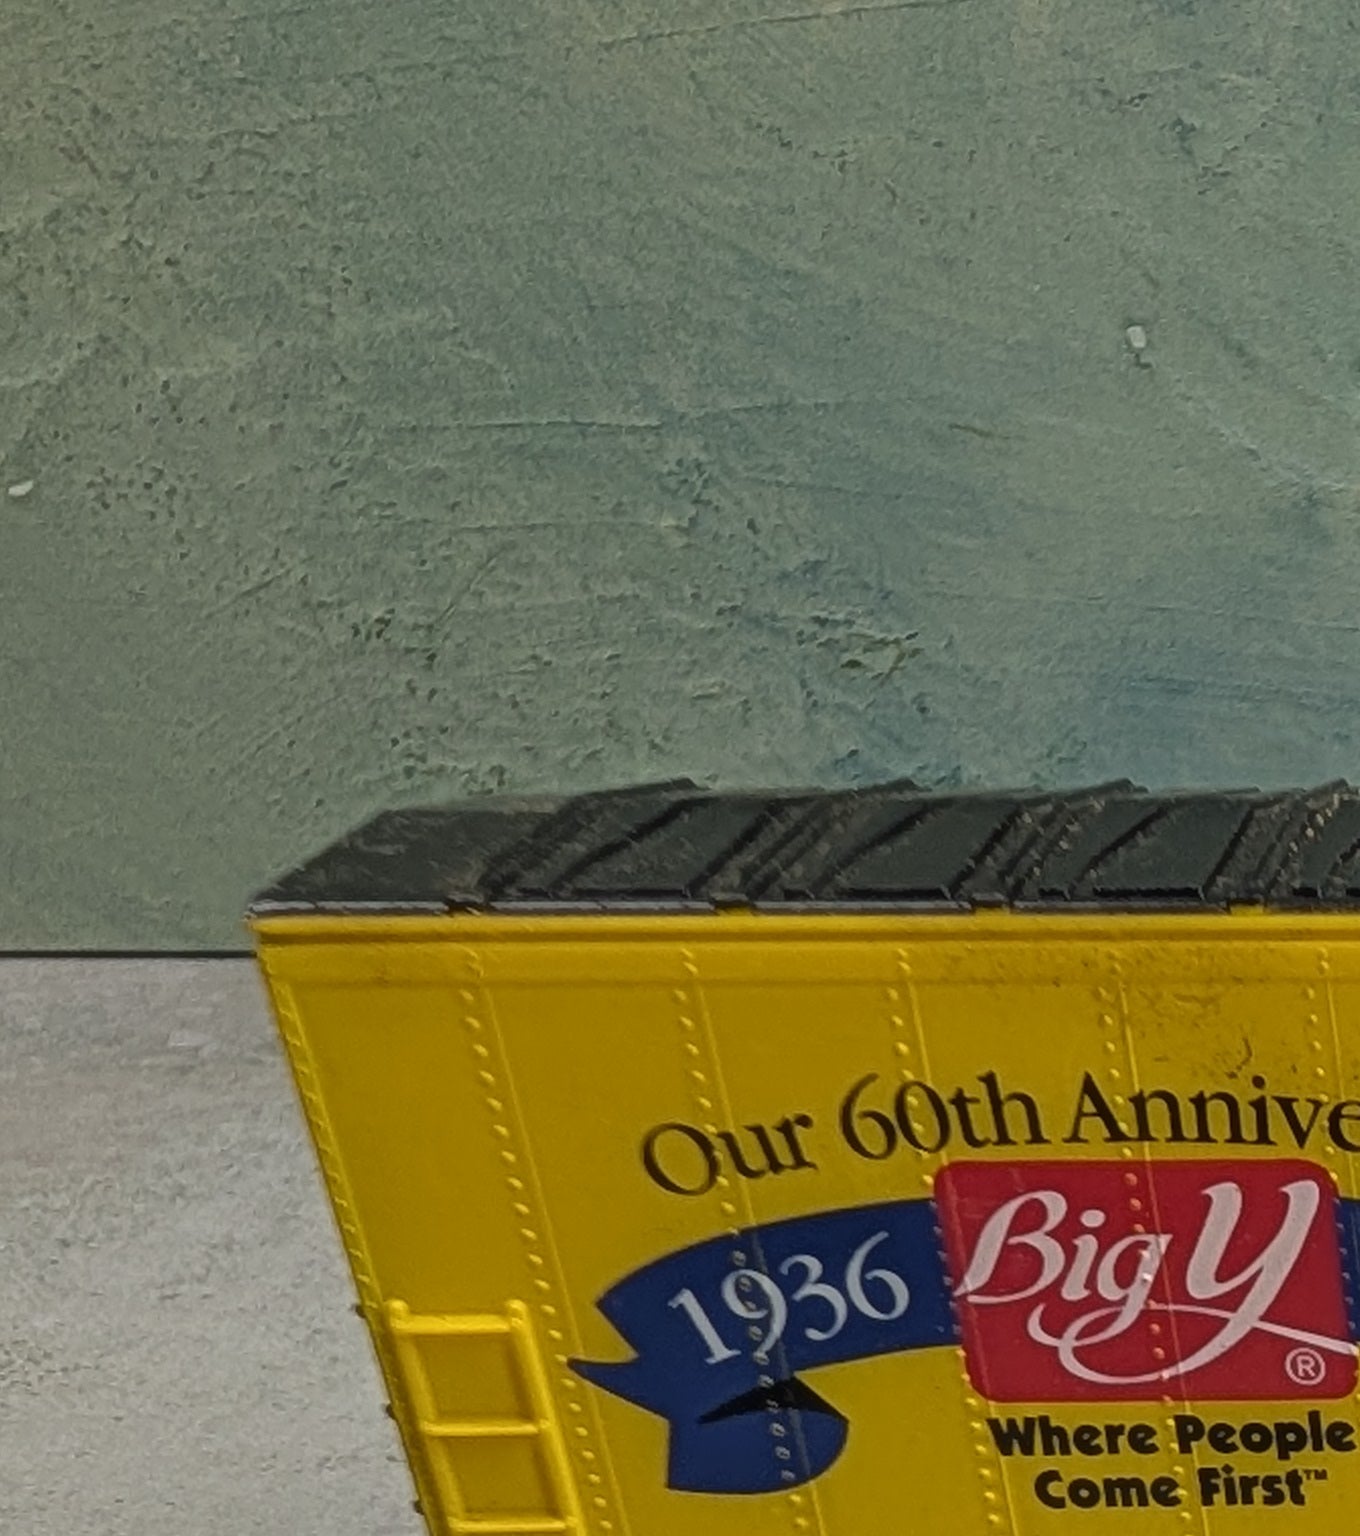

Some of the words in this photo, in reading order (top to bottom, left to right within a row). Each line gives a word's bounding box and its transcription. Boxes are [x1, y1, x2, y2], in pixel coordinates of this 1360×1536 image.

[642, 1113, 819, 1196] Our
[838, 1071, 1053, 1161] 60th
[668, 1230, 911, 1366] 1936
[955, 1190, 1173, 1349] Big
[986, 1414, 1160, 1457] Where
[1174, 1410, 1357, 1461] People
[1034, 1469, 1183, 1510] Come
